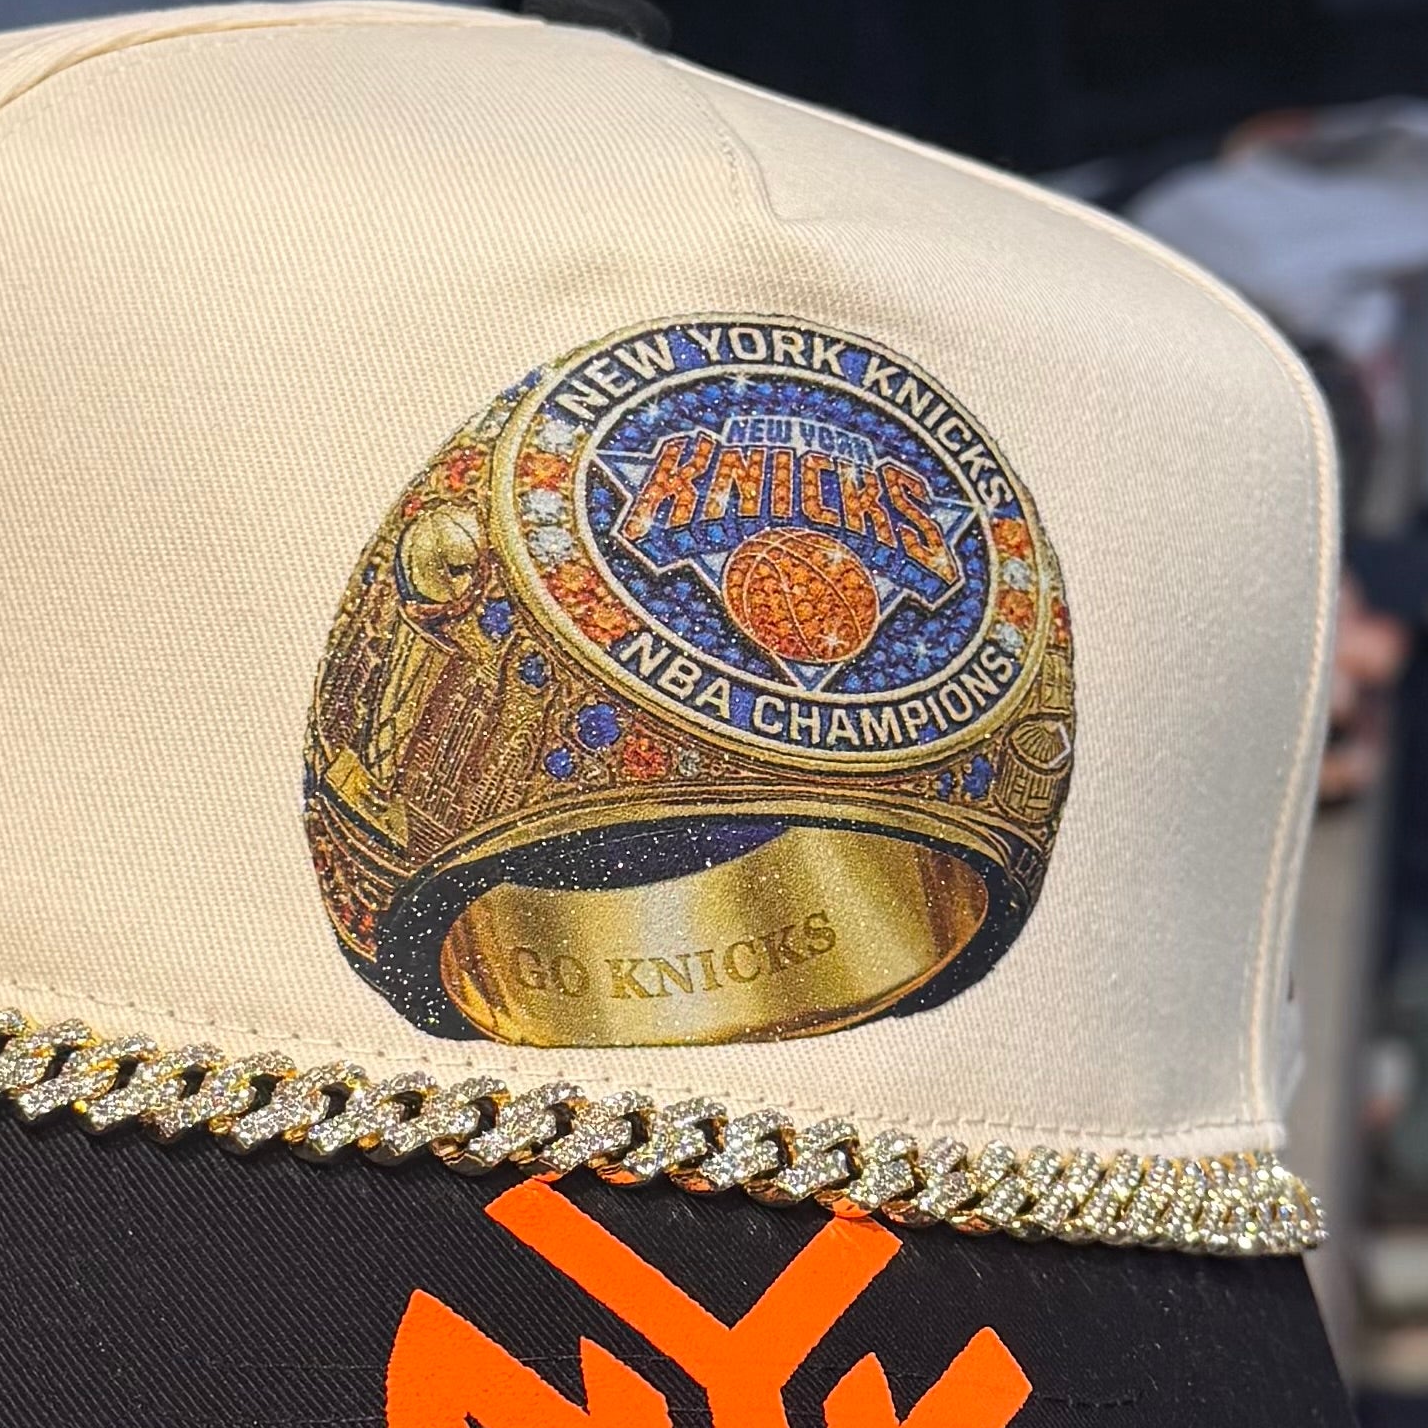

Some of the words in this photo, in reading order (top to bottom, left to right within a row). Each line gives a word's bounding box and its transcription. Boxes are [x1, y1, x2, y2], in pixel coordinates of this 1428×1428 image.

[556, 330, 676, 424] NEW
[696, 324, 848, 374] YORK
[861, 358, 1015, 506] KNICKS
[726, 418, 792, 444] NEW
[619, 430, 960, 585] KNICKS
[620, 630, 733, 721] NBA
[752, 643, 1015, 750] CHAMPIONS
[510, 944, 590, 998] GO
[604, 909, 837, 1000] KNICKS
